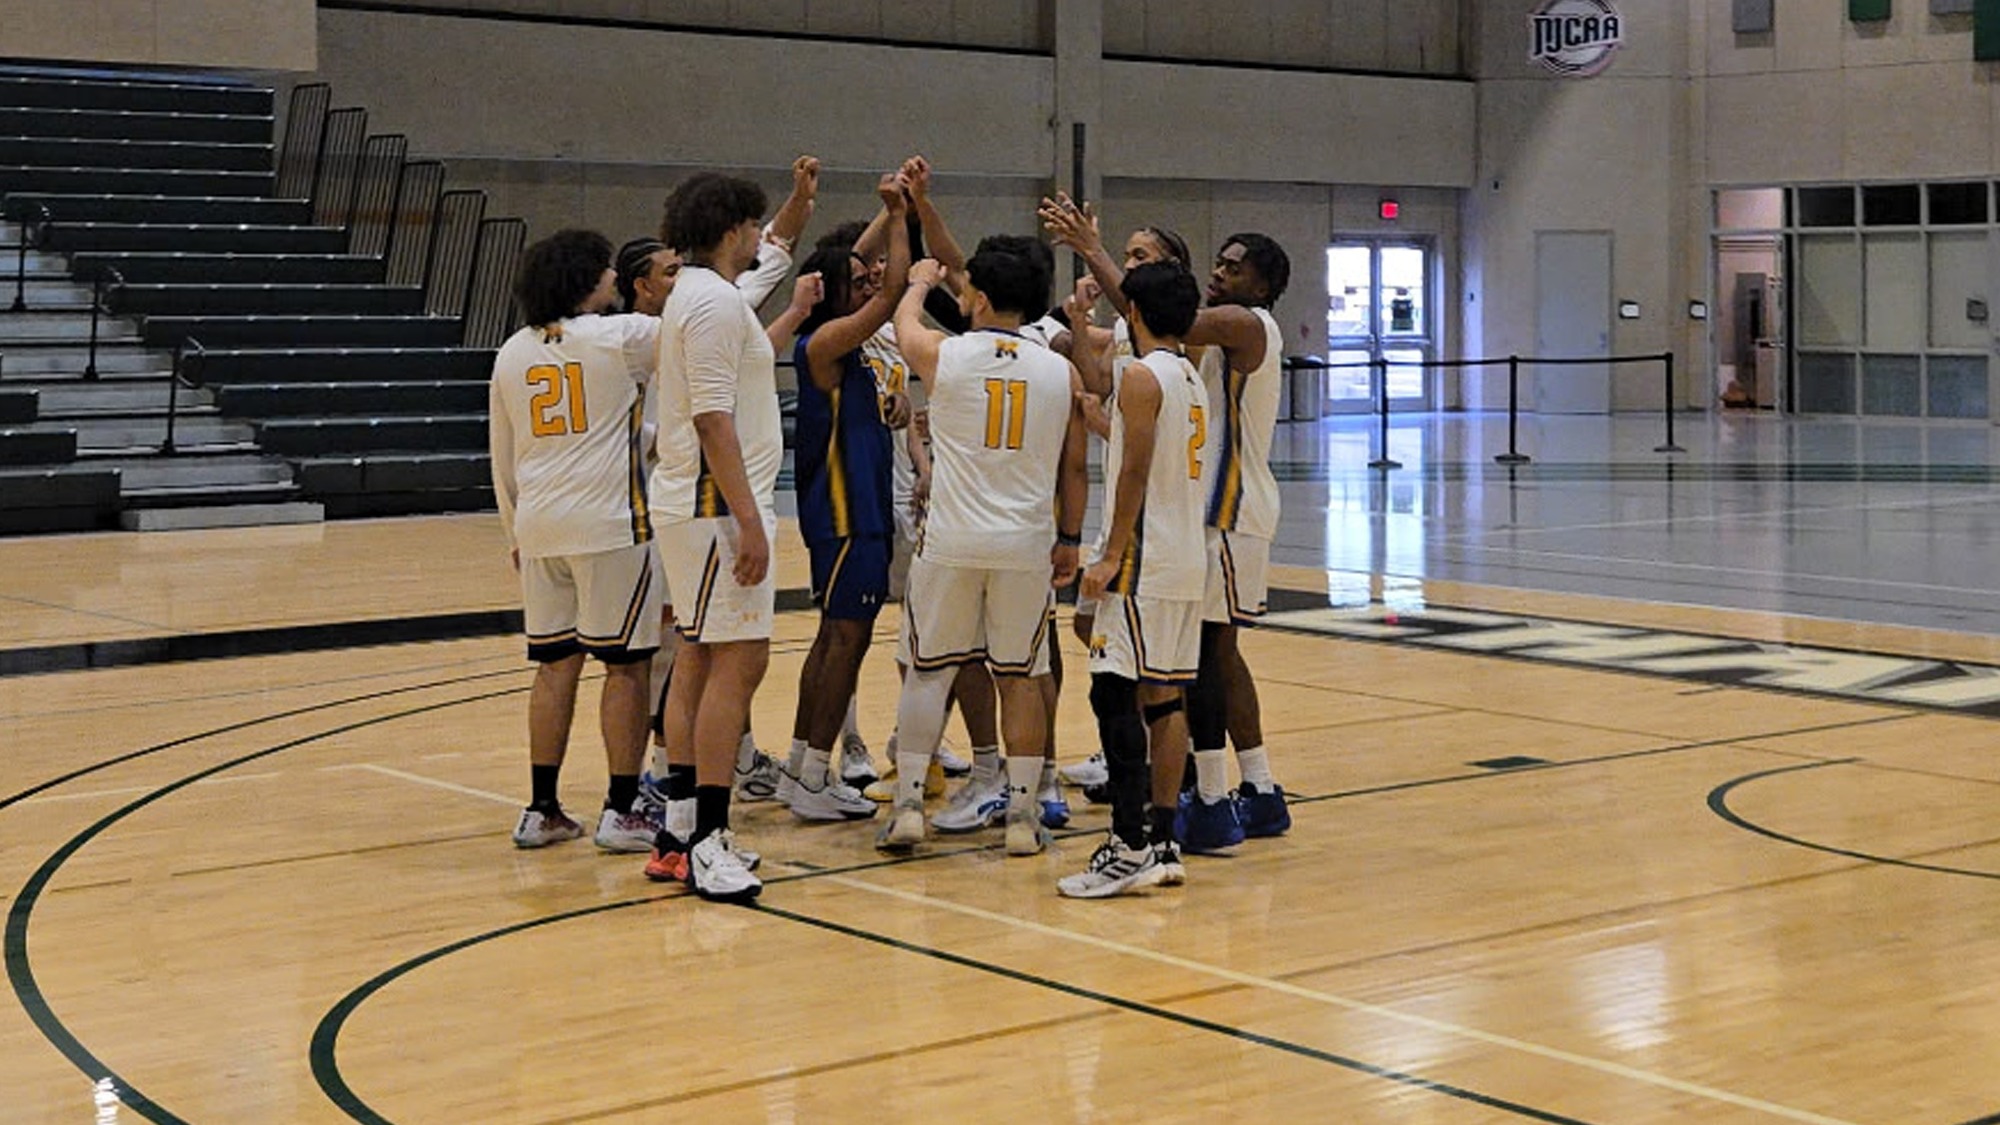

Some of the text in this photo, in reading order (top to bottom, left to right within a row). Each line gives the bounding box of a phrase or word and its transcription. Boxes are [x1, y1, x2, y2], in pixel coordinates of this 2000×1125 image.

[1532, 15, 1619, 56] NJCAA
[526, 361, 588, 437] 21
[984, 377, 1028, 450] 11
[1187, 404, 1206, 480] 2
